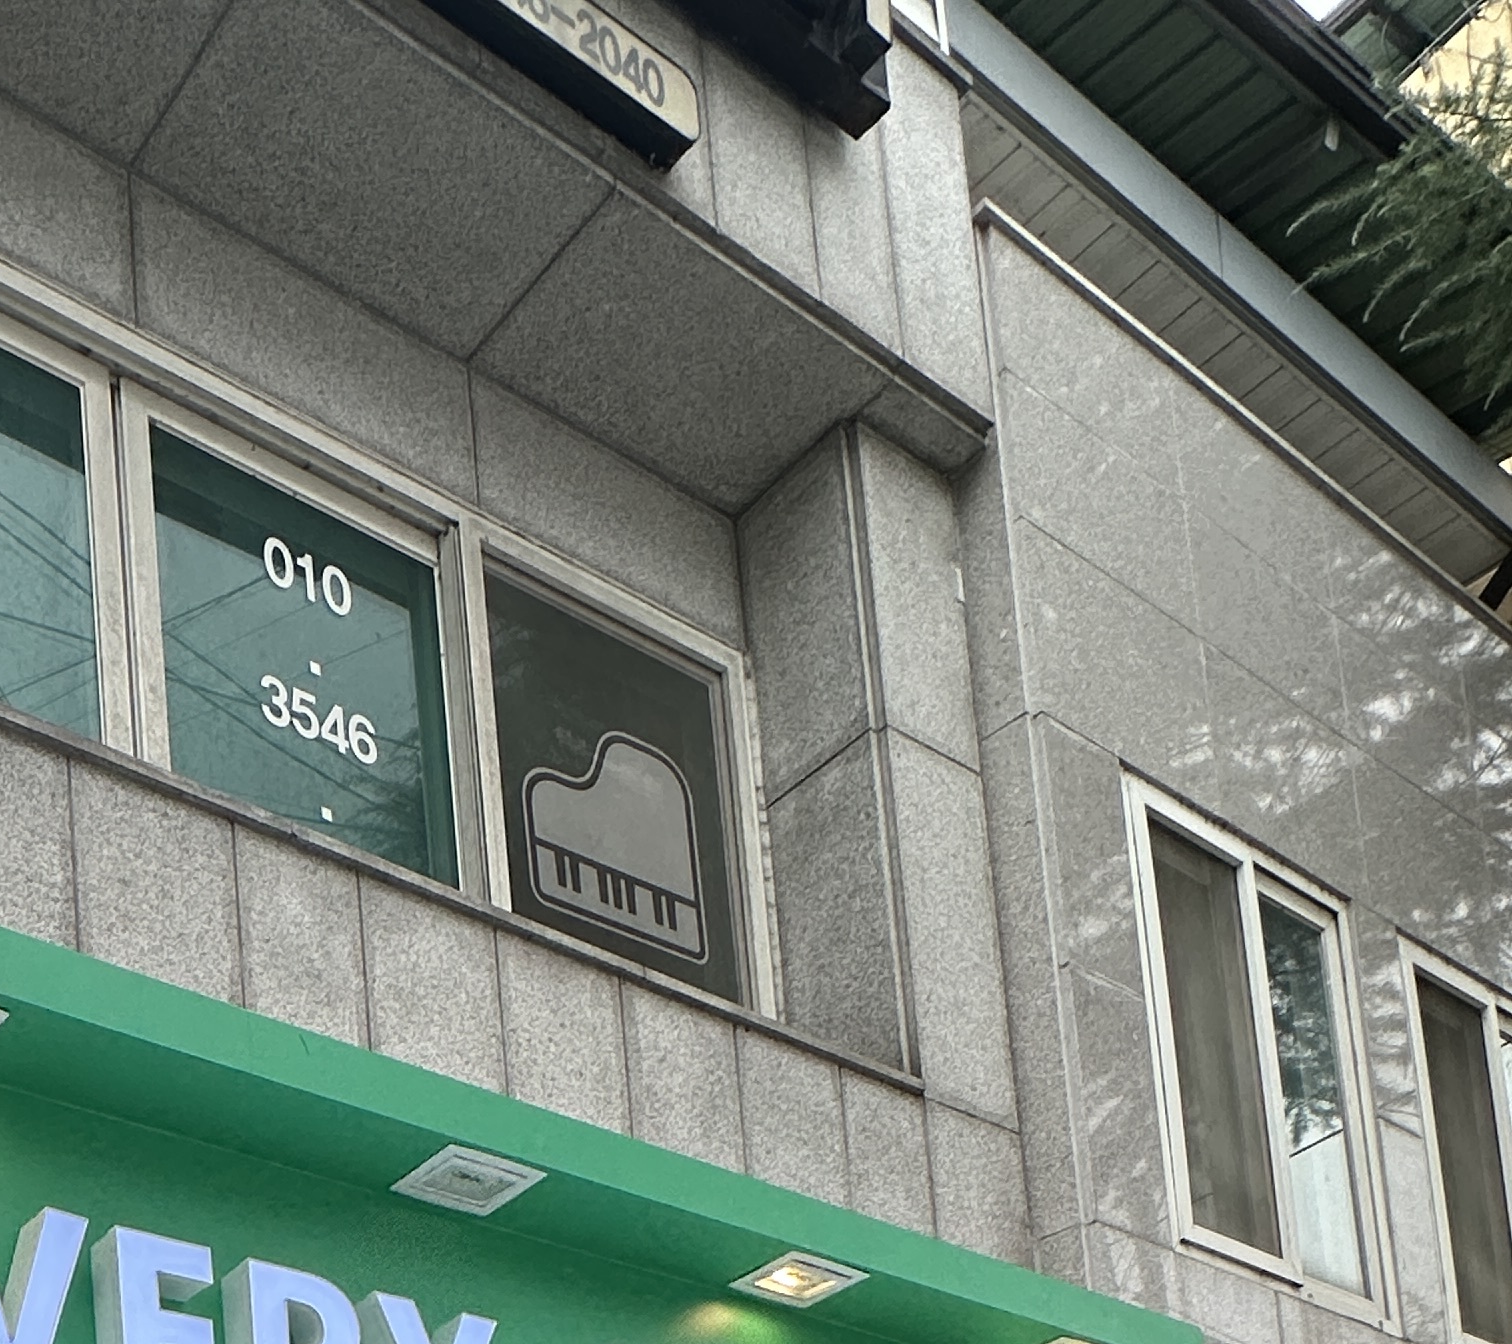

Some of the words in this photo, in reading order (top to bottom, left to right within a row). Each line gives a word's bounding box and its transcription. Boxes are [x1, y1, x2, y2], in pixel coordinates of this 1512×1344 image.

[518, 0, 665, 107] -2040
[263, 536, 352, 616] 010
[259, 675, 378, 764] 3546
